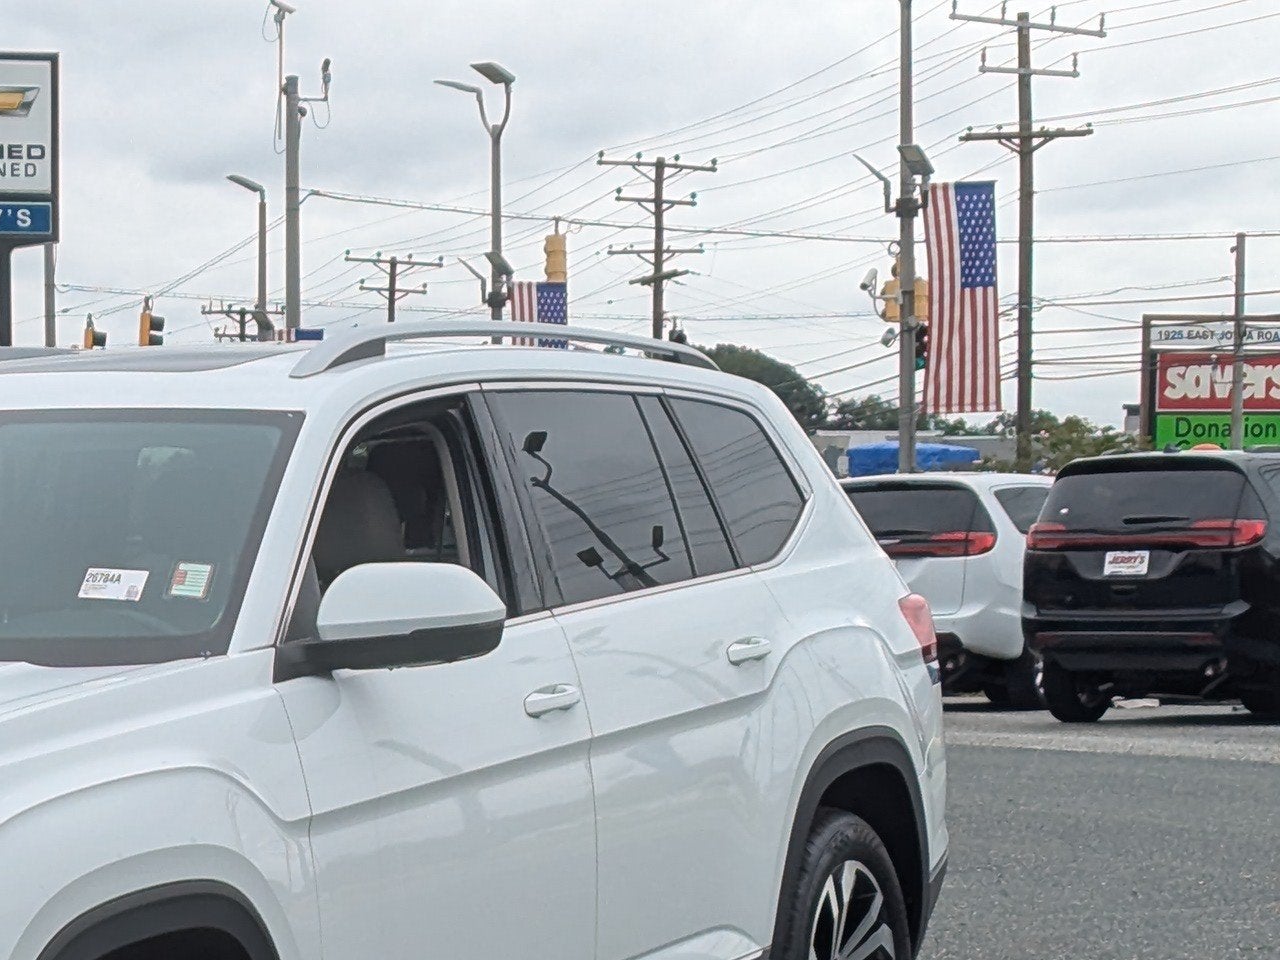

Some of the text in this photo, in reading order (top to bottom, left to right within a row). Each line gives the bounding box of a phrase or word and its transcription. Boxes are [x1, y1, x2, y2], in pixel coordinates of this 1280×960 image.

[1157, 330, 1184, 341] 1925
[1187, 330, 1215, 341] EAST
[1219, 330, 1254, 341] JOA
[1175, 416, 1277, 438] Donaion
